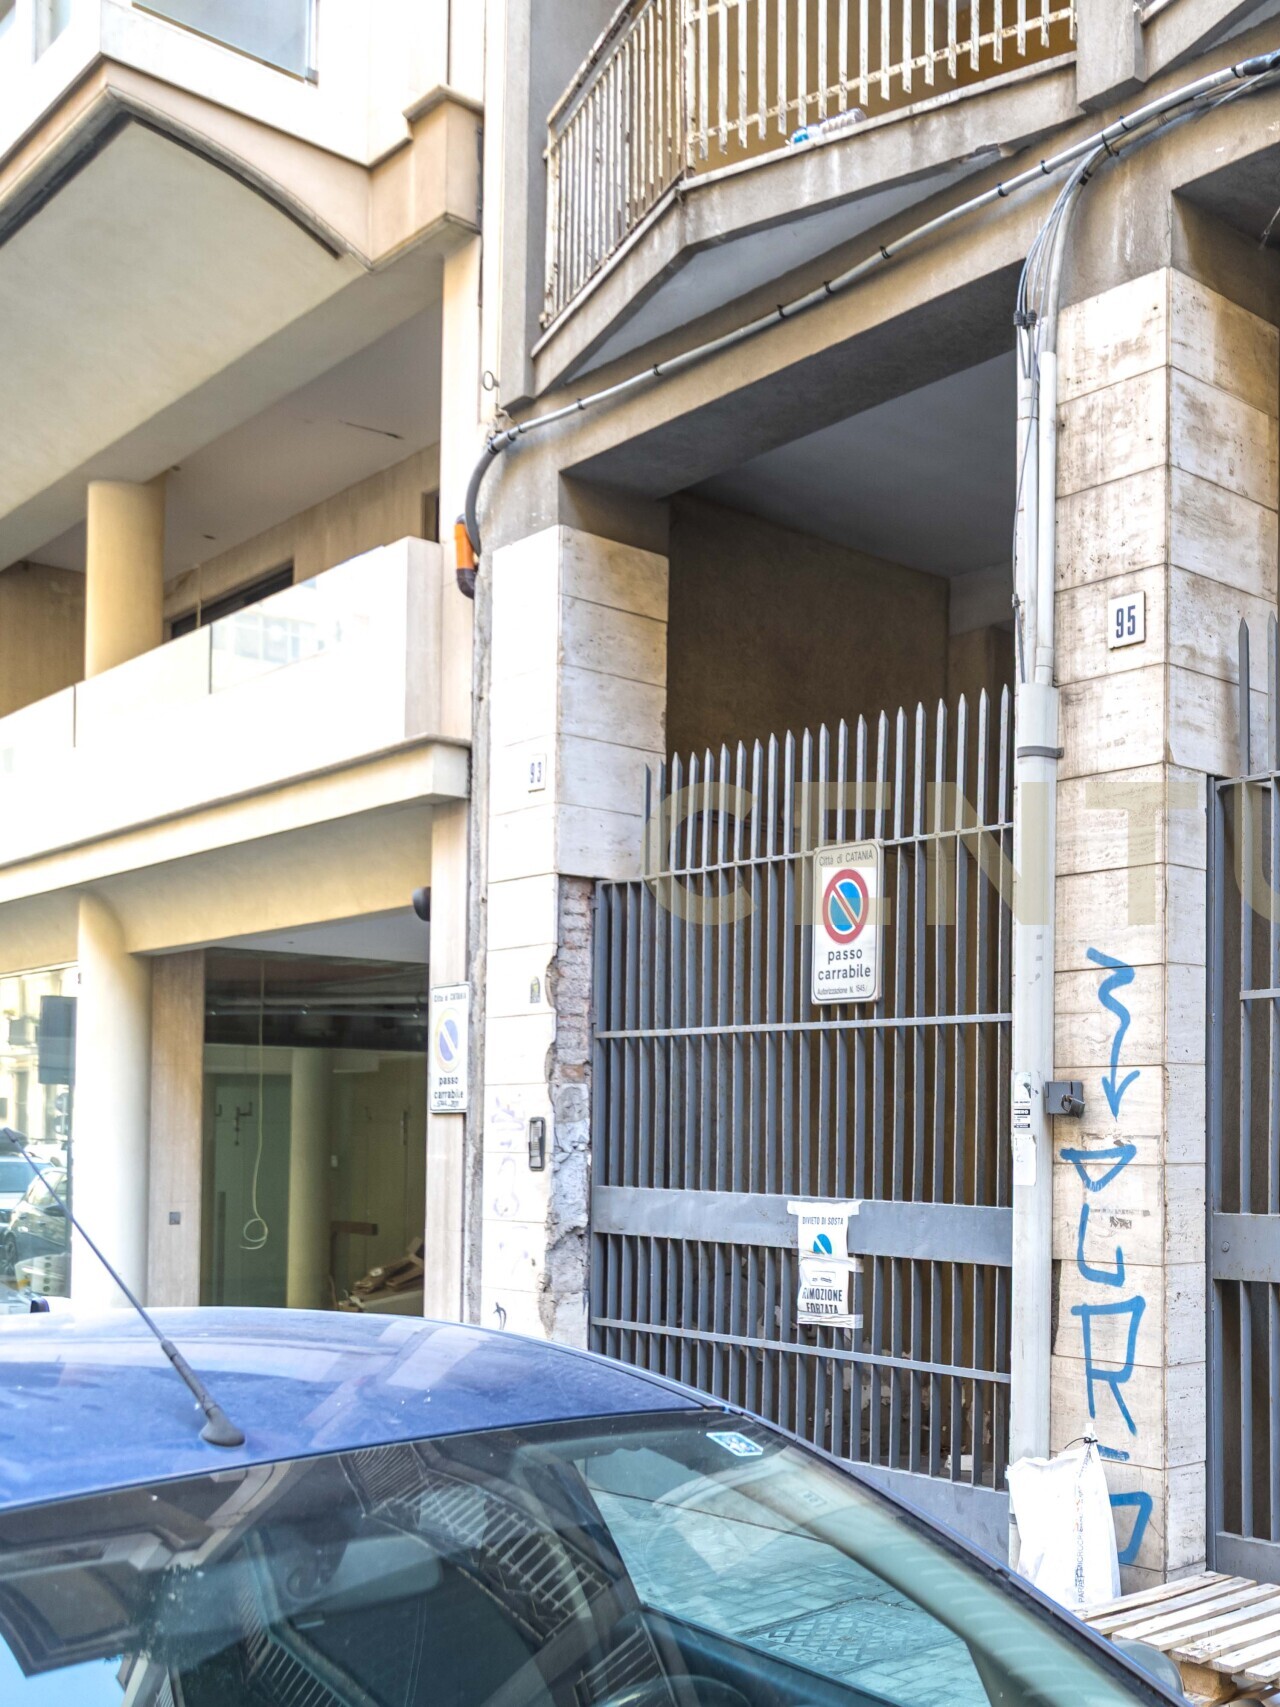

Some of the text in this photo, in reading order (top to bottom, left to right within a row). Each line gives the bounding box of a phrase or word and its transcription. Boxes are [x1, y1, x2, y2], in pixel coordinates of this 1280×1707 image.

[1116, 605, 1136, 638] 95
[819, 849, 873, 866] Città di CATANIA
[828, 949, 863, 965] passo
[818, 964, 871, 981] carrabile
[817, 986, 848, 996] Autorizzazione
[439, 1077, 458, 1087] passo
[434, 1089, 464, 1099] carrabile
[802, 1217, 843, 1225] DIVIETO DI SOSTA
[802, 1287, 843, 1302] RIMOZIONE
[806, 1302, 839, 1314] FORZATA
